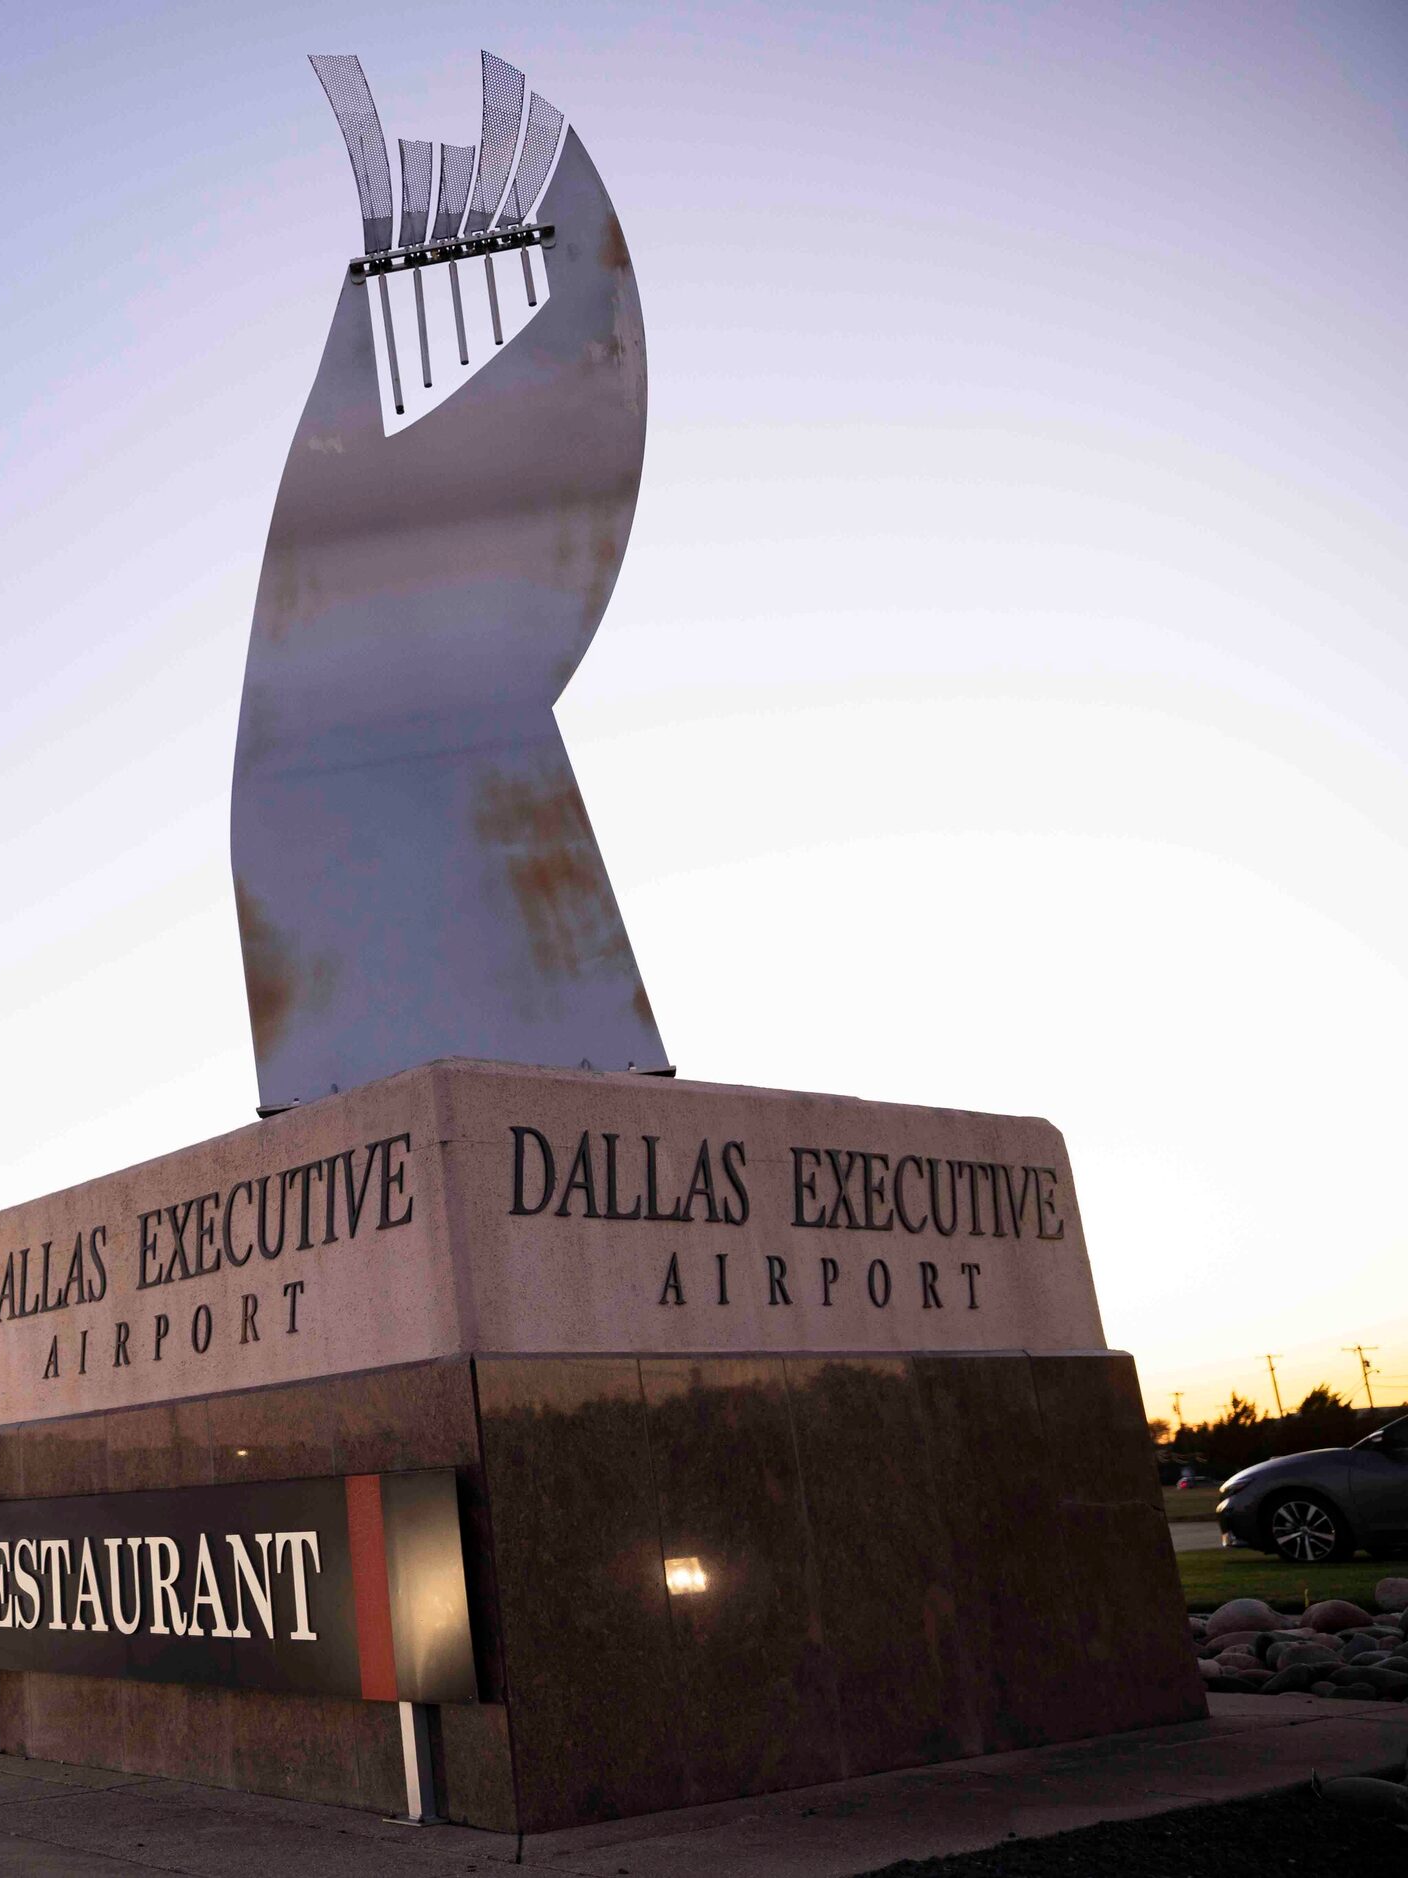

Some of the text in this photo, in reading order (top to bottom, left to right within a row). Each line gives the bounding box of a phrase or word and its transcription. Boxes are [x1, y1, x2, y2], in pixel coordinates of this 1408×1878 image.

[136, 1132, 414, 1291] EXECUTIVE
[509, 1125, 1066, 1241] DALLAS EXECUTIVE
[42, 1280, 305, 1380] AIRPORT
[658, 1250, 982, 1310] AIRPORT
